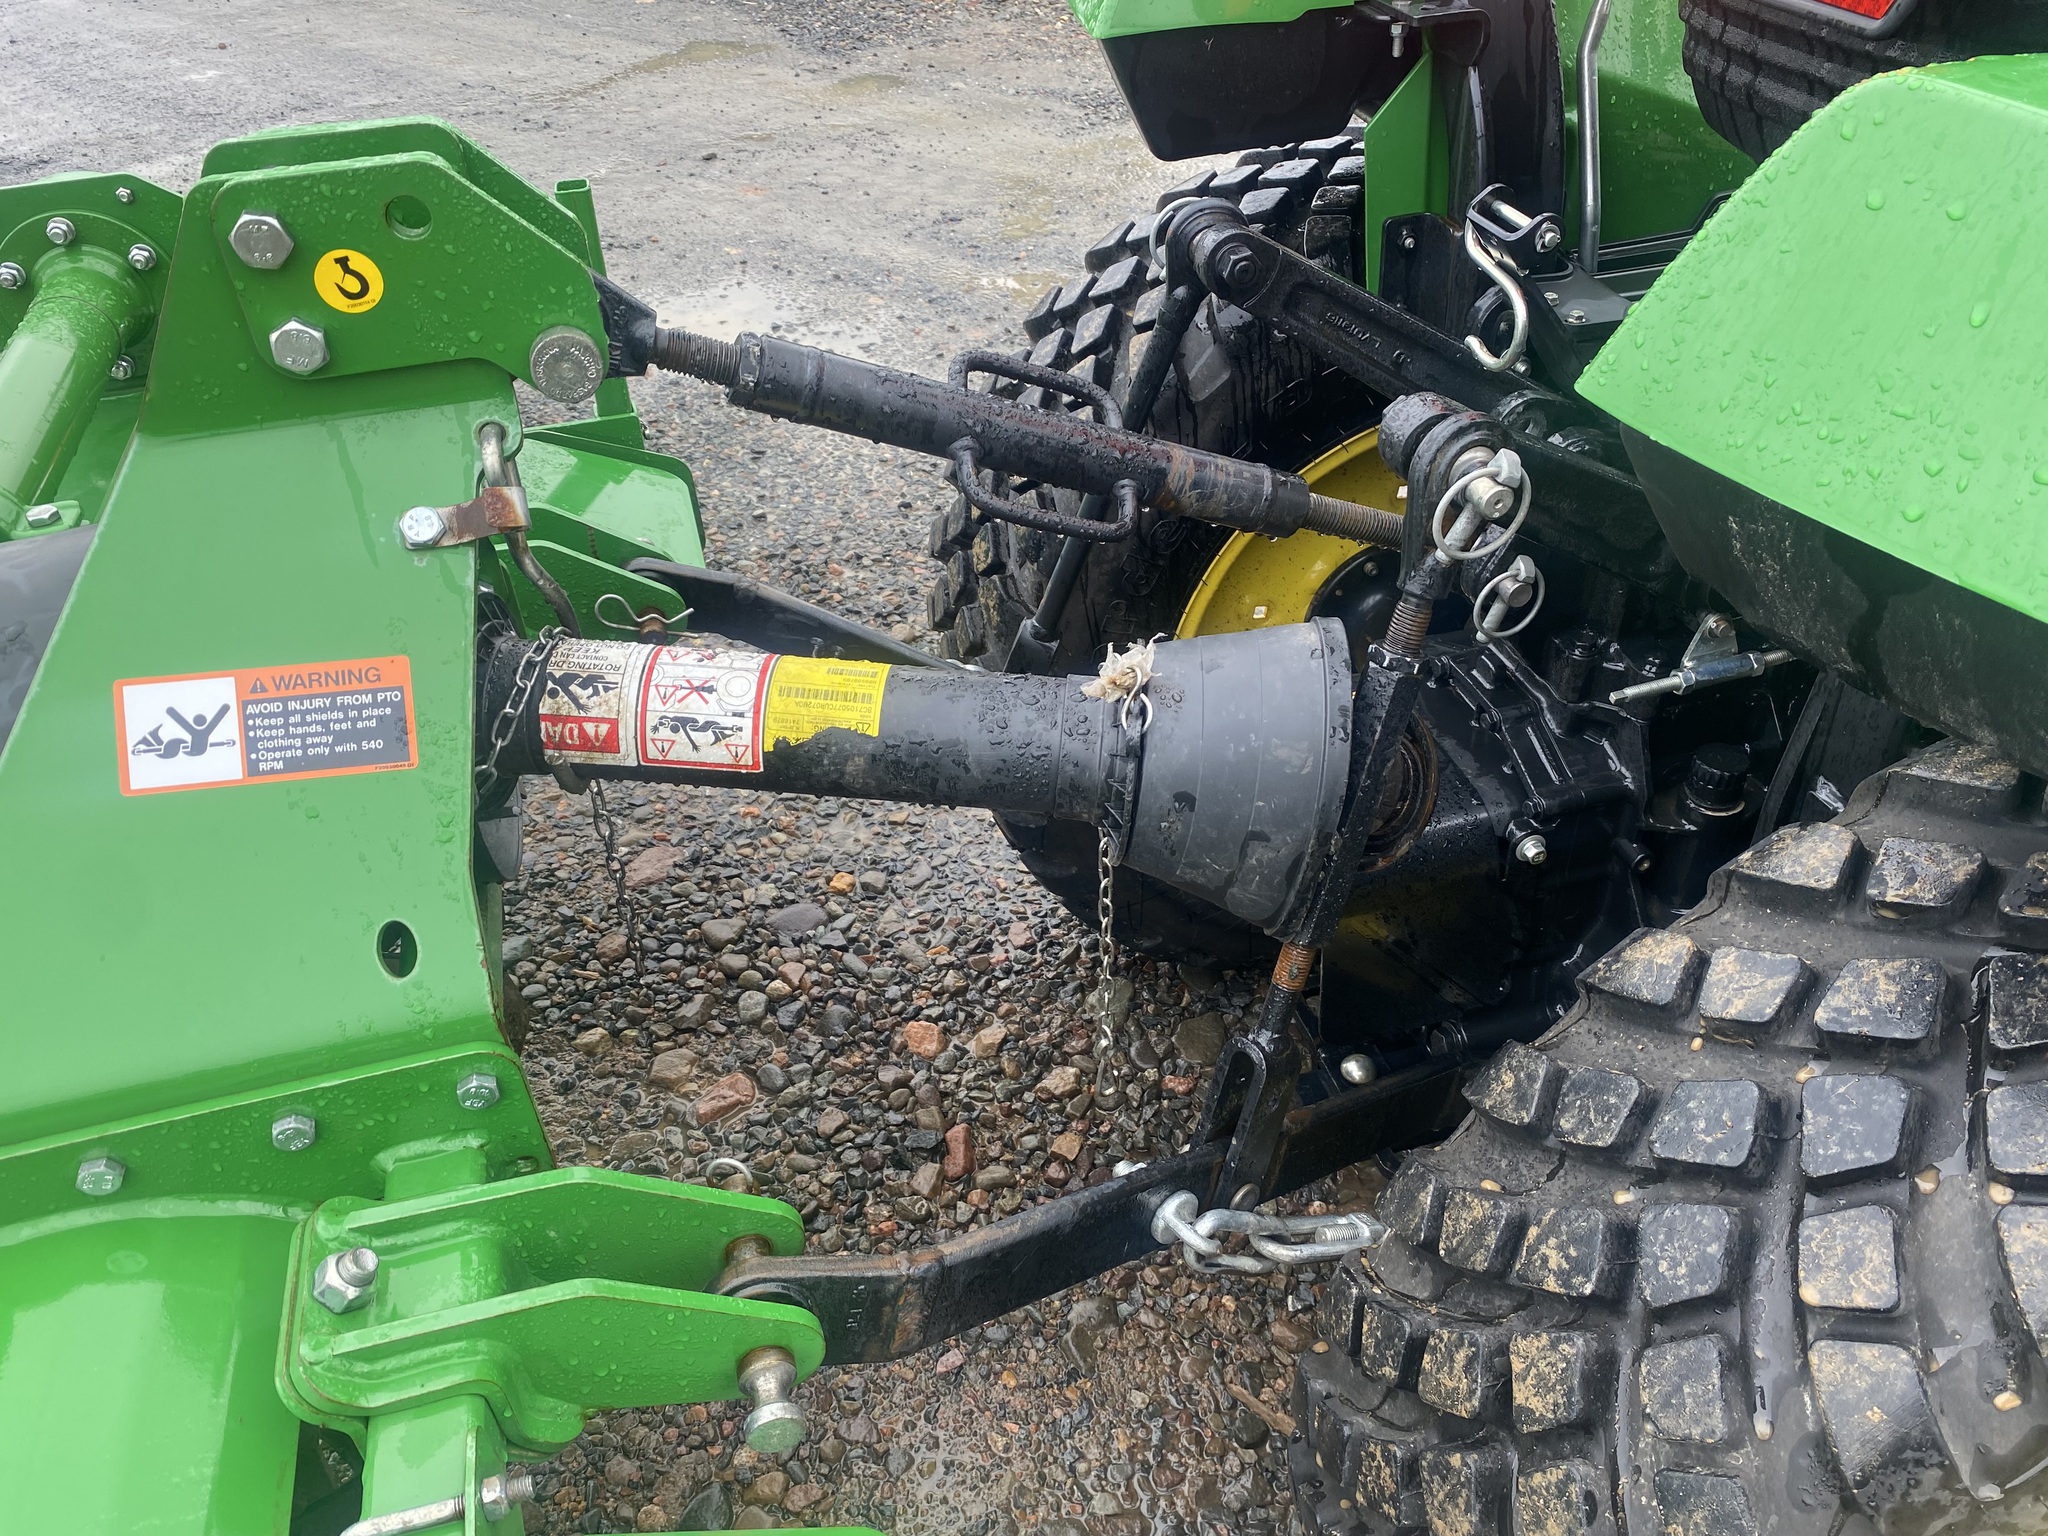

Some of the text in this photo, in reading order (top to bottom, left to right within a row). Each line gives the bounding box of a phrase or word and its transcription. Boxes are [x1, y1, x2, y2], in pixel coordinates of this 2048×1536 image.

[567, 661, 621, 671] ROTATING
[576, 653, 608, 661] CONTACT
[271, 666, 381, 691] WARNING
[245, 690, 401, 714] AVOID INJURY FROM PTO
[255, 705, 391, 727] Keep all shields in place
[256, 717, 376, 738] Keep hands, feet and
[257, 734, 333, 749] clothing away
[258, 739, 383, 760] Operate only with 540
[258, 760, 283, 771] RPM
